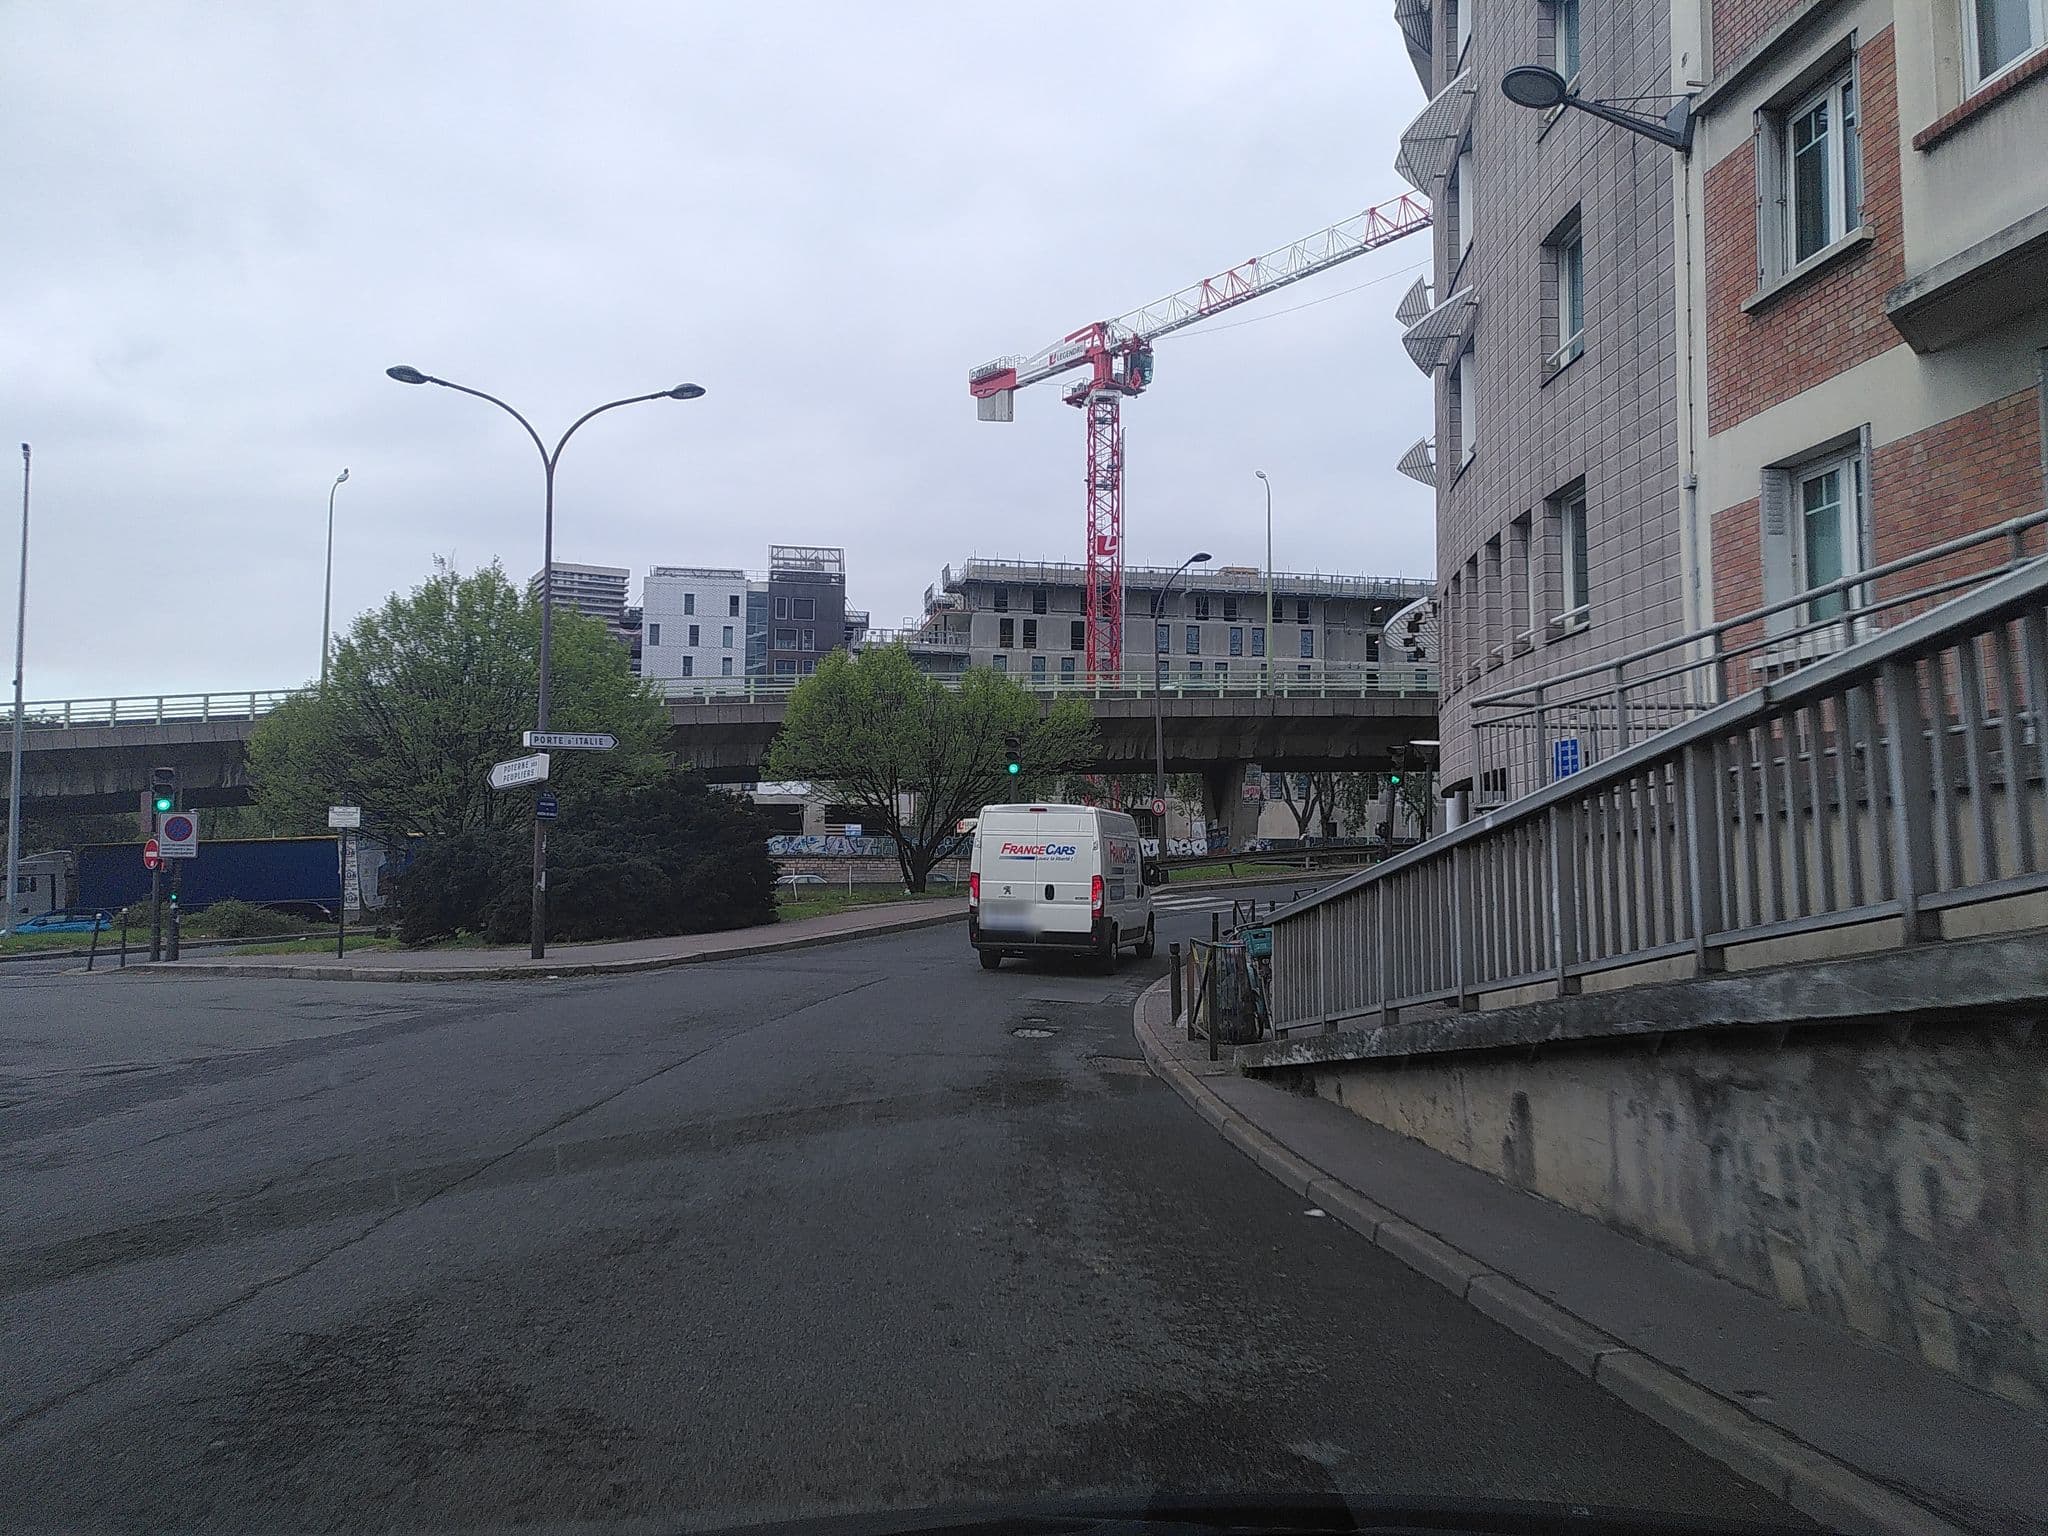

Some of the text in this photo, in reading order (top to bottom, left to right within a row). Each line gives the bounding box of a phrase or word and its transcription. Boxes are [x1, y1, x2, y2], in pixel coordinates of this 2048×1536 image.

[533, 736, 563, 744] PORTE
[503, 760, 529, 773] POTERNE
[502, 768, 535, 783] PEUPLIERS
